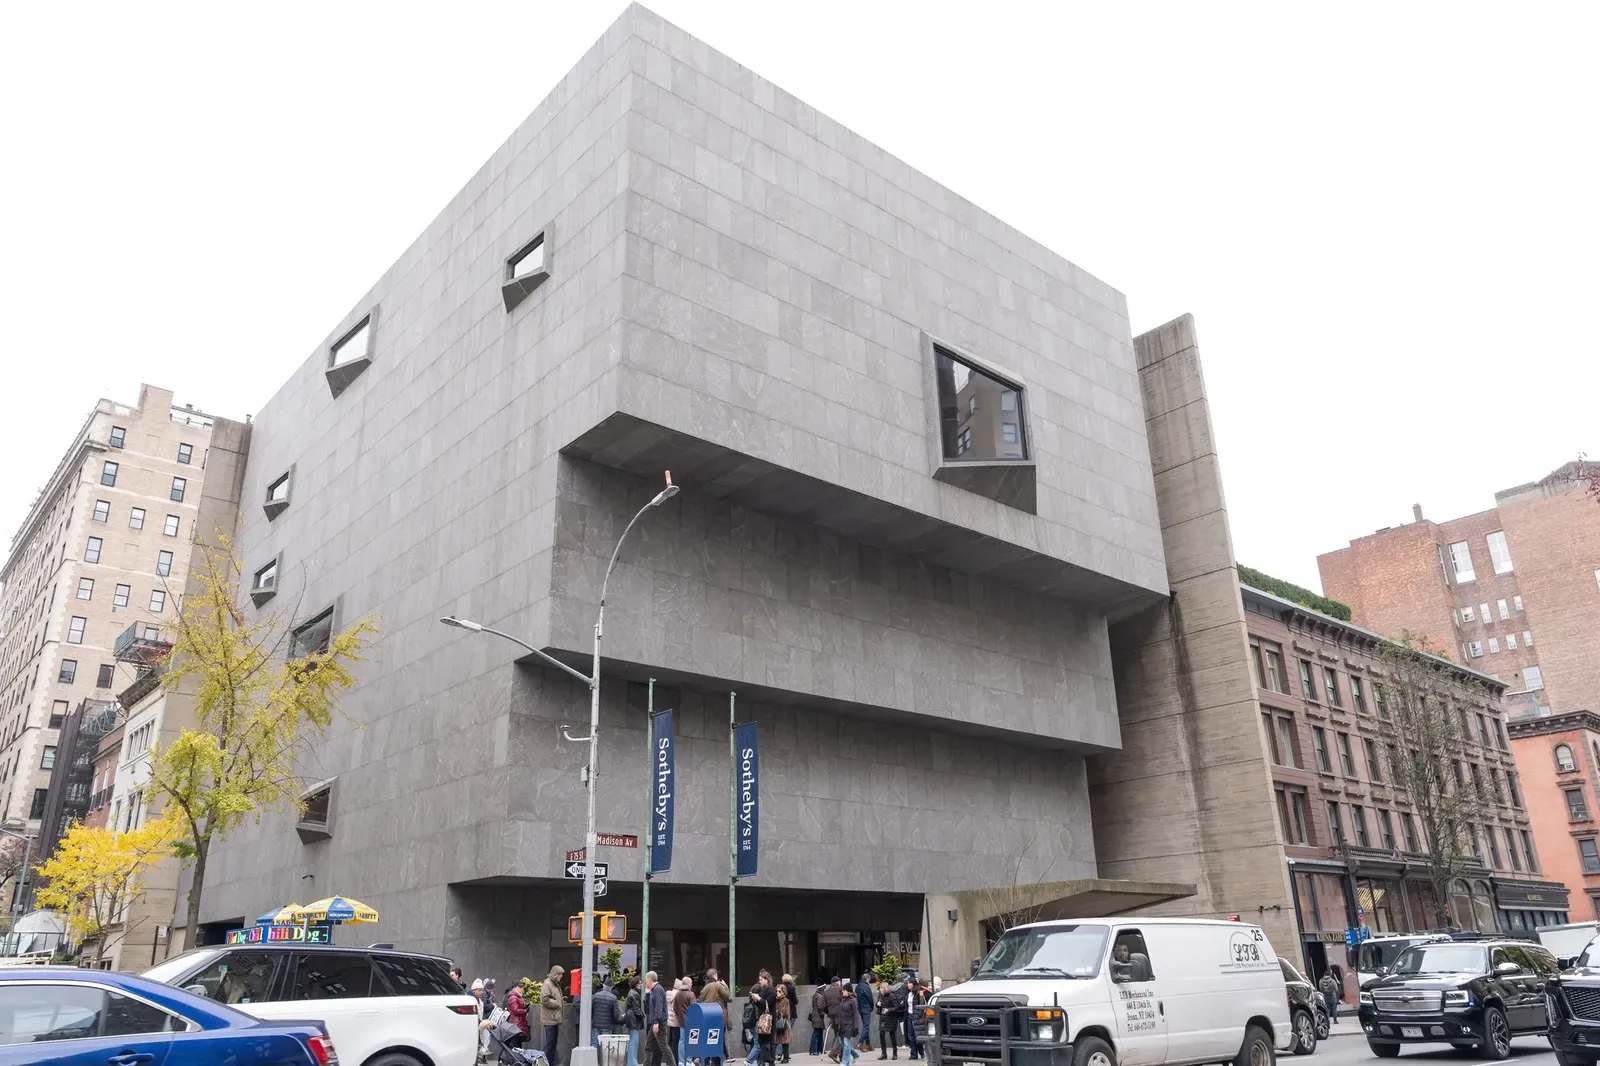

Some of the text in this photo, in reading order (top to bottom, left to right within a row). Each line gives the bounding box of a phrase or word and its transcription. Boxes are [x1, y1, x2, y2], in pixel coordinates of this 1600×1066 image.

[655, 737, 671, 831] Sotheby's
[739, 748, 756, 837] Sotheby's
[597, 836, 634, 847] Madison Av
[1250, 930, 1264, 942] 25
[894, 942, 913, 953] NEW
